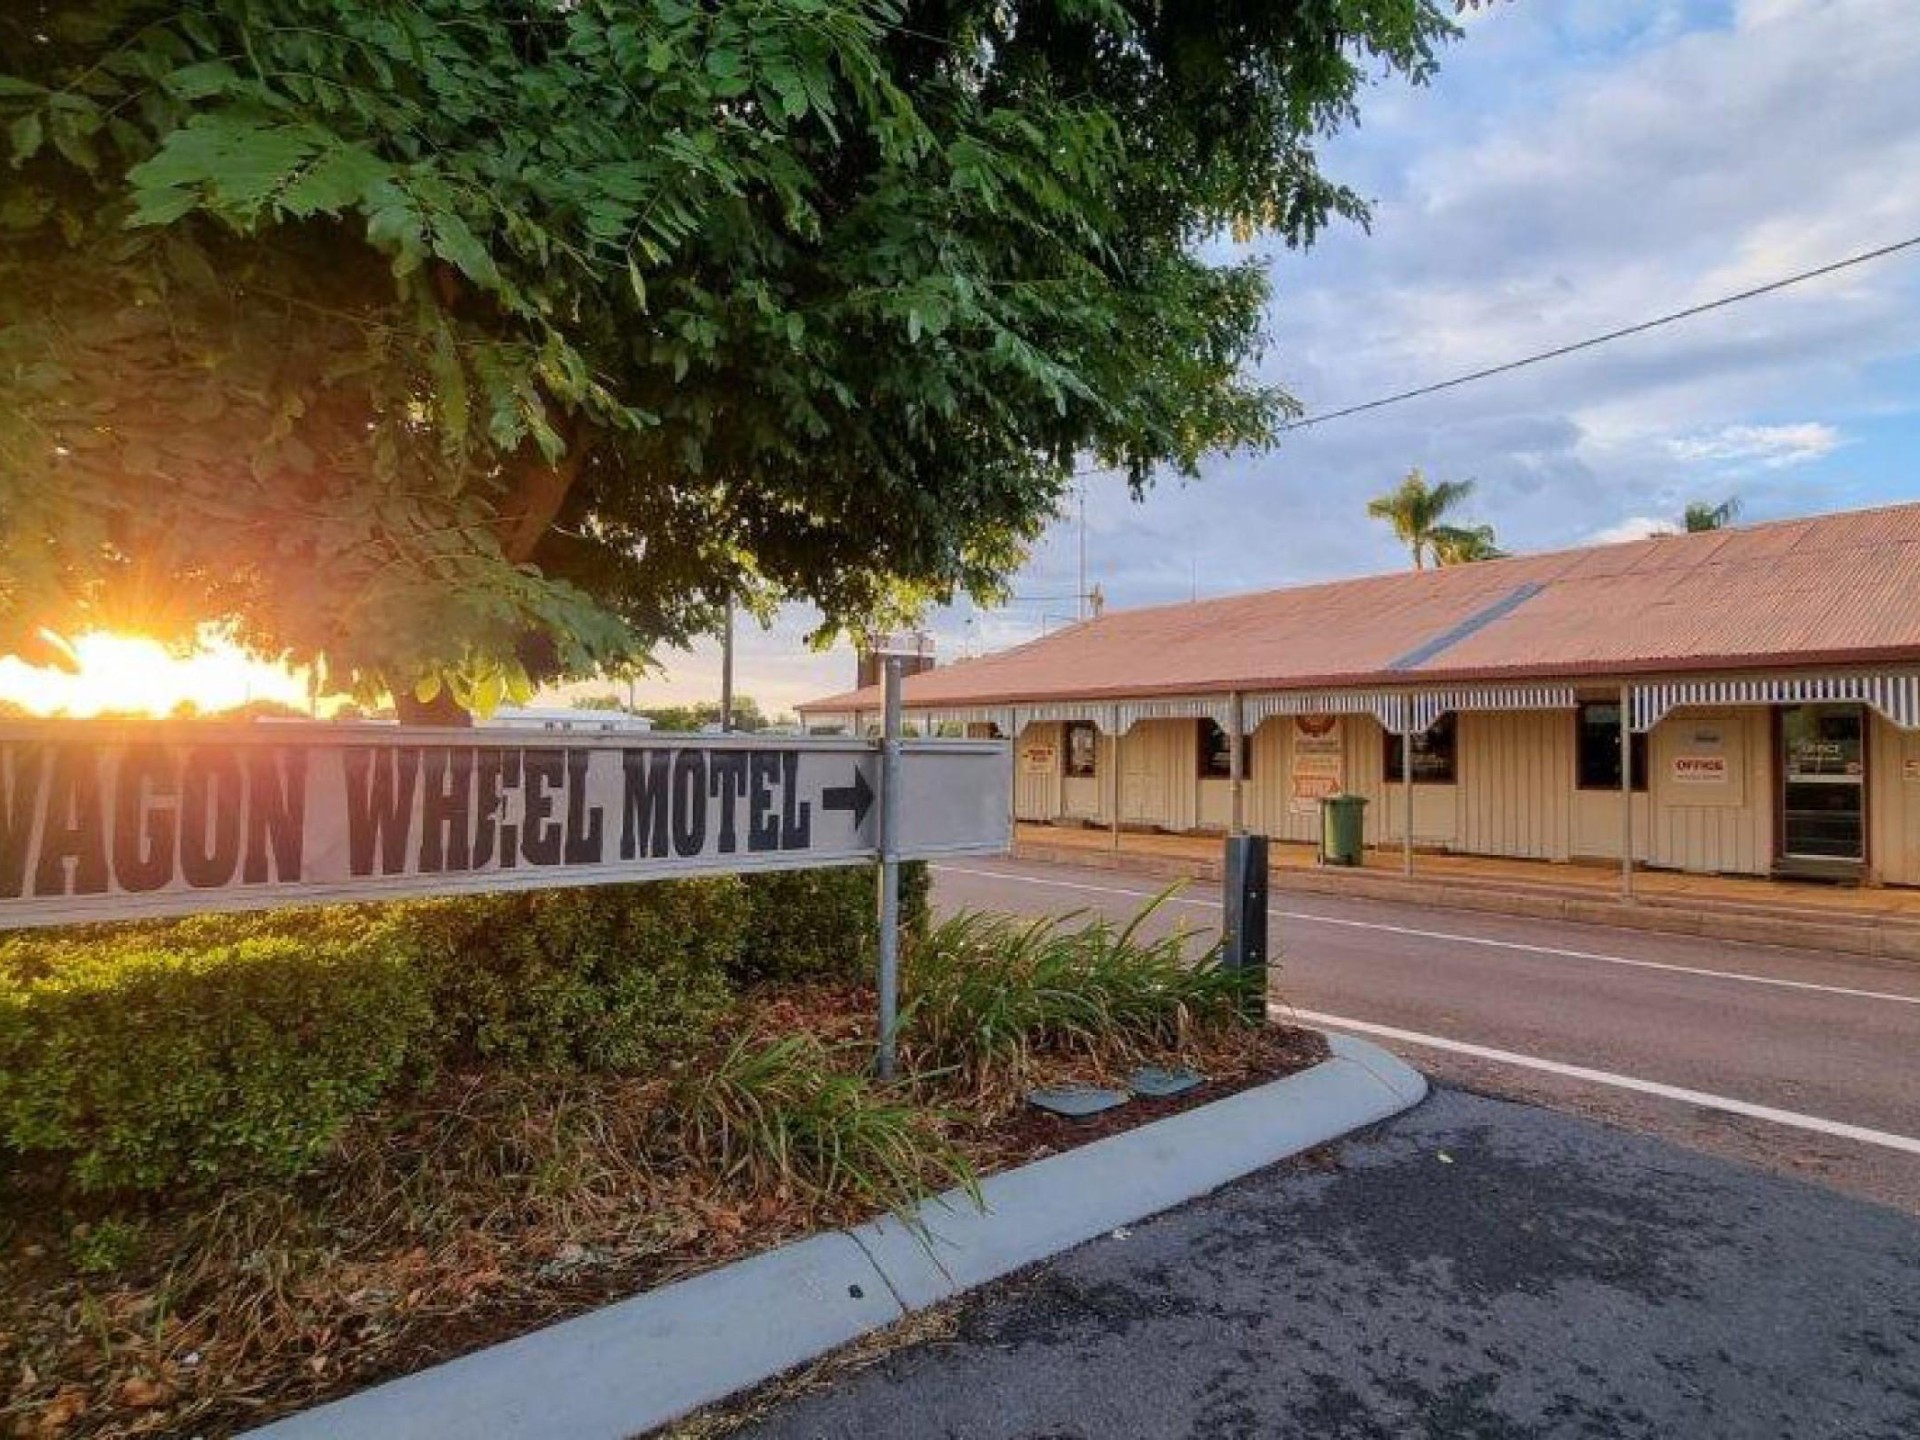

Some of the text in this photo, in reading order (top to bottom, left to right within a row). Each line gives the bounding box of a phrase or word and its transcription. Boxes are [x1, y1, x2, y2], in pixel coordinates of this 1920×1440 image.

[1676, 759, 1724, 771] OFFICE
[343, 746, 602, 875] WHEEL
[620, 749, 811, 860] MOTEL
